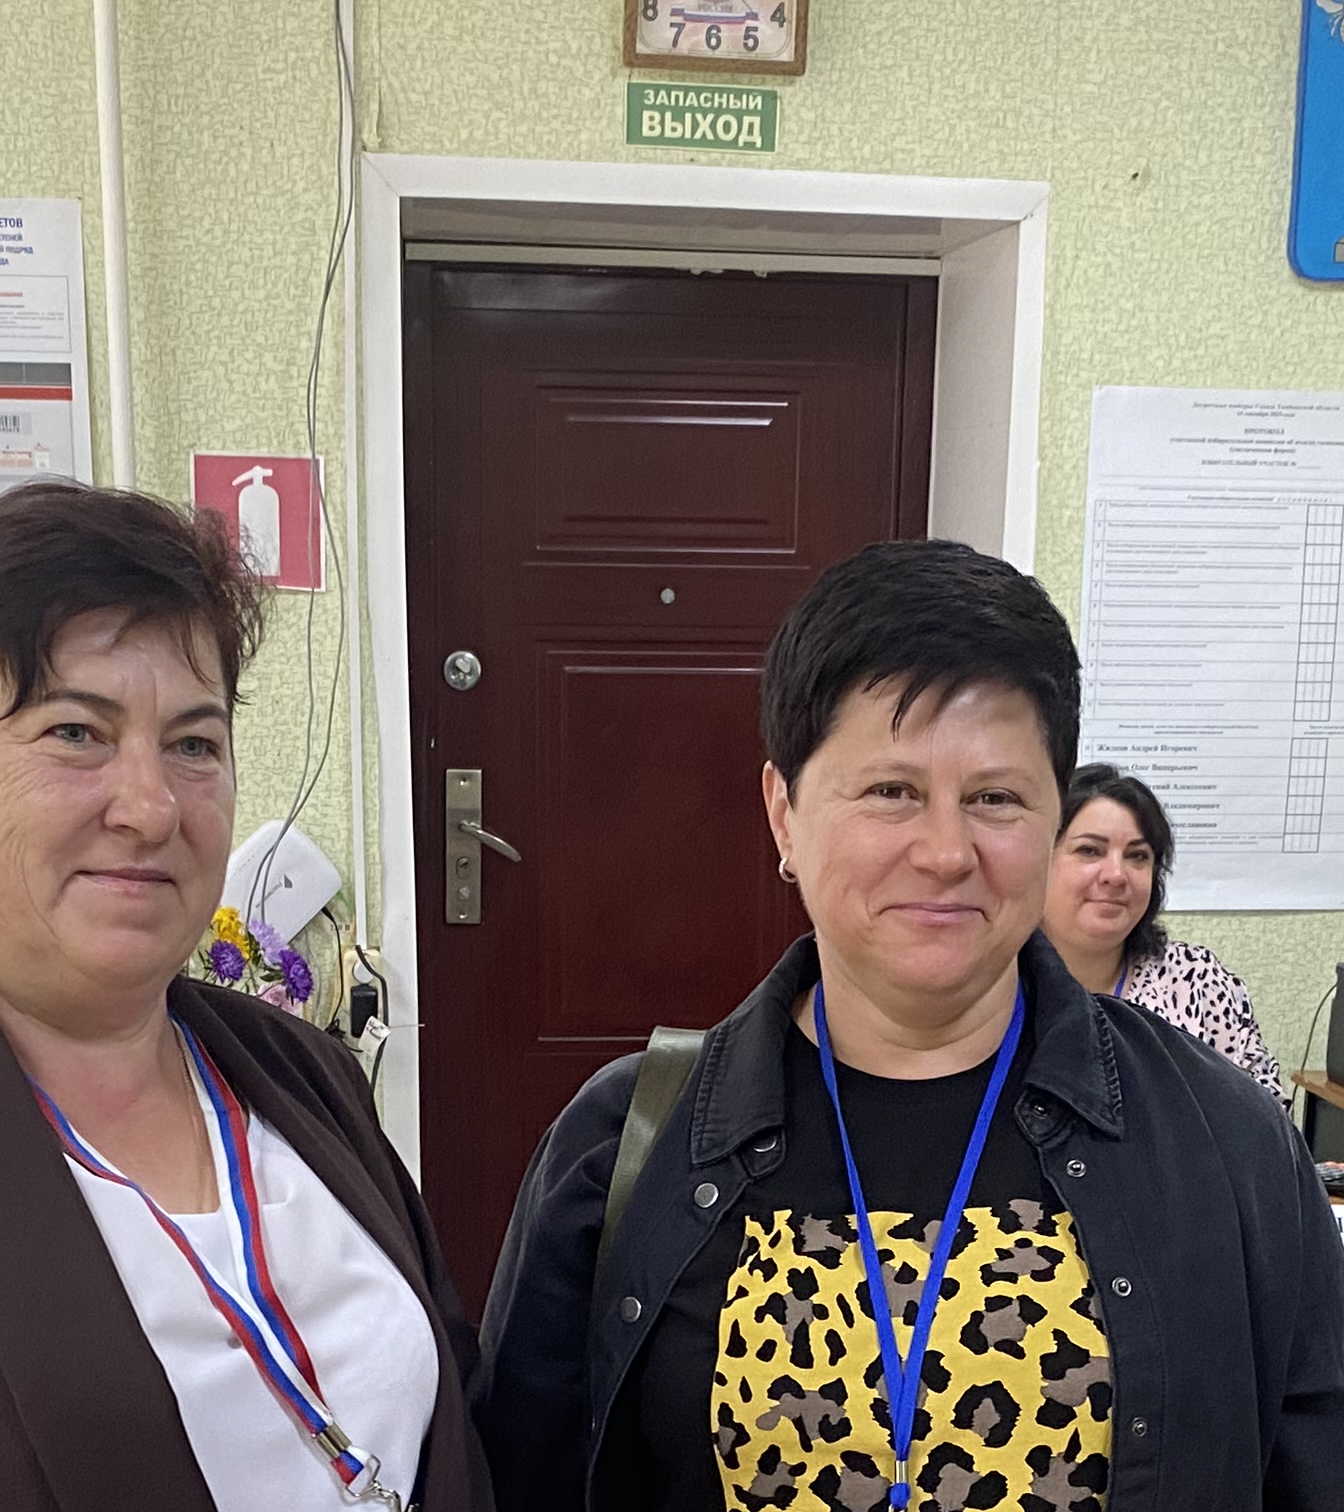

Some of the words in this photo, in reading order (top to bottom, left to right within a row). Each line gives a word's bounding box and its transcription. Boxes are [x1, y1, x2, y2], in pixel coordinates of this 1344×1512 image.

[642, 0, 658, 21] 8
[770, 2, 786, 28] 4
[670, 23, 686, 48] 7
[706, 25, 721, 50] 6
[743, 26, 758, 51] 5
[644, 89, 762, 111] ЗАПАСНЫЙ
[641, 110, 762, 148] ВЫХОД
